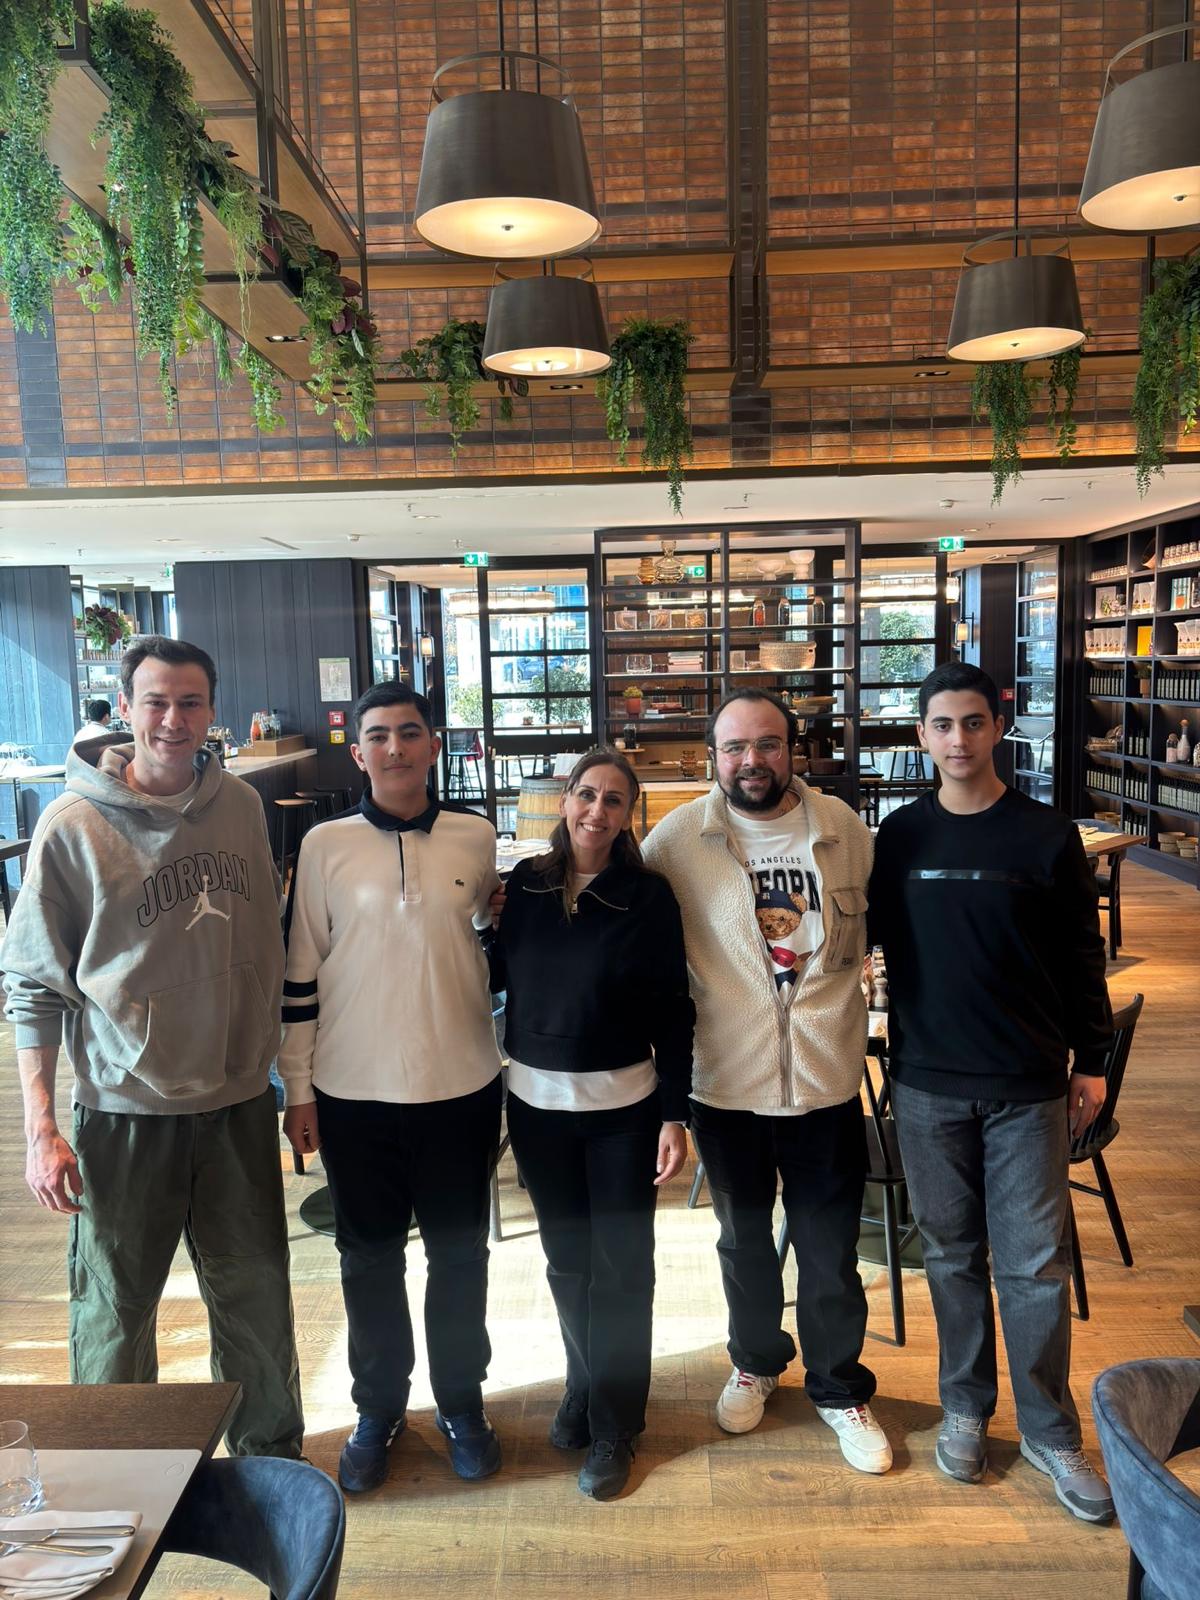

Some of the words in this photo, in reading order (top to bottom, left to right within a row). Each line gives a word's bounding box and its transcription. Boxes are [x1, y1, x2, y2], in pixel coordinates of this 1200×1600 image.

[744, 859, 756, 868] OS
[760, 856, 802, 865] ANGELES
[137, 851, 250, 928] JORDAN
